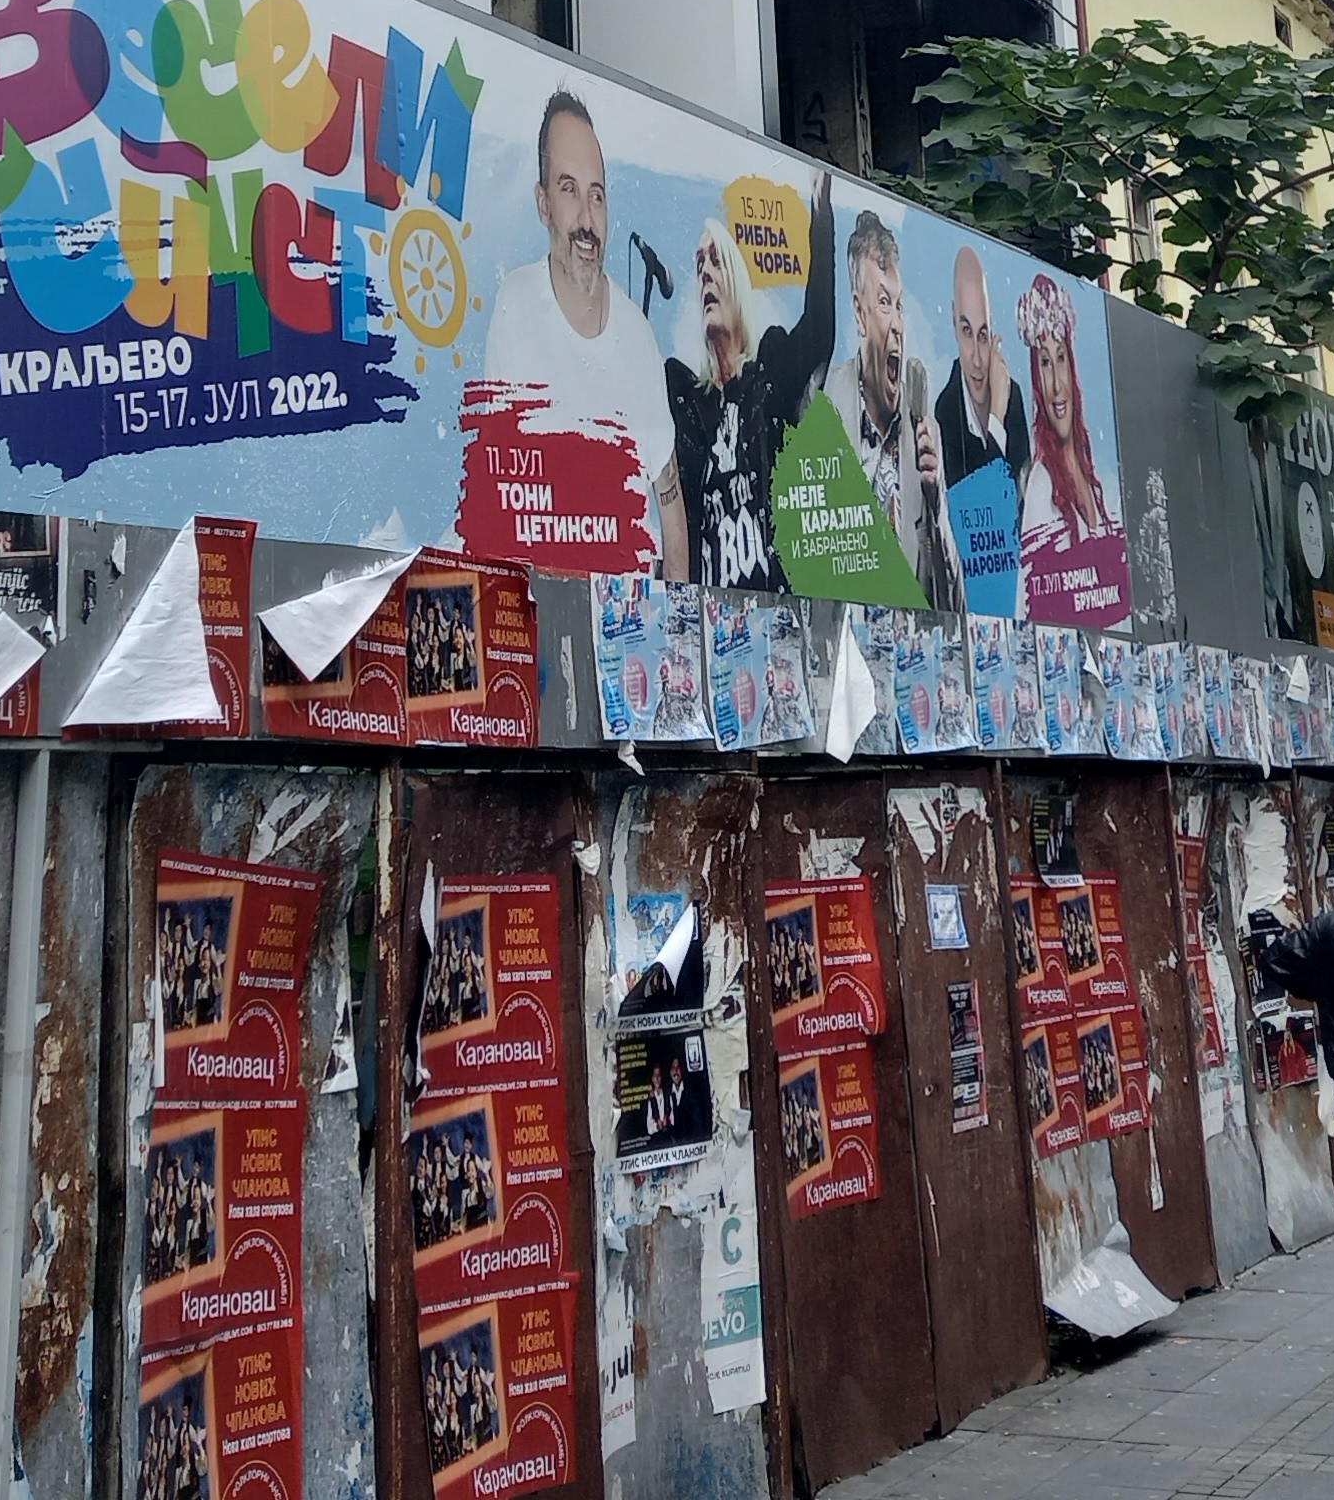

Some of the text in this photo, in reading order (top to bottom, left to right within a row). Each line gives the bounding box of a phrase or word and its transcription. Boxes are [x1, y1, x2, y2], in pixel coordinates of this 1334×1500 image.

[740, 196, 785, 222] 15. ЈУЛ
[734, 222, 789, 249] РИБЉА
[753, 251, 802, 275] ЧОРБА
[114, 371, 349, 434] 15-17. ЈУЛ 2022.
[485, 446, 543, 477] 11. ЈУЛ
[798, 456, 842, 482] 16. ЈУЛ
[497, 482, 553, 512] ТОНИ
[788, 484, 826, 510] НЕЛЕ
[515, 514, 618, 546] ЦЕТИНСКИ
[801, 504, 874, 535] КАРАЈЛИЋ
[959, 507, 994, 530] 16. ЈУЛ
[791, 531, 869, 559] И ЗАБРАЊЕНО
[970, 529, 1006, 553] БОЈАН
[199, 554, 227, 572] ПИС
[832, 551, 880, 576] ПУШЕЊЕ
[201, 577, 231, 596] ОВИХ
[1044, 572, 1061, 595] ЈУЛ
[1062, 566, 1100, 592] ЗОРИЦА
[202, 602, 240, 618] АНОВА
[1073, 585, 1121, 613] БРУНЦЛИК
[308, 700, 400, 741] Карановац
[451, 708, 527, 742] Карановац
[508, 908, 535, 924] УПИС
[505, 928, 540, 945] НОВИХ
[499, 949, 548, 966] ЧЛАНОВА
[637, 1013, 663, 1028] НОВИХ
[663, 1011, 699, 1026] ЧЛАНОВА
[798, 1011, 862, 1038] Карановац
[187, 1046, 275, 1086] Карановац
[456, 1040, 543, 1070] Карановац
[515, 1104, 543, 1122] УПИС
[246, 1128, 277, 1148] УПИС
[514, 1125, 549, 1145] НОВИХ
[241, 1153, 282, 1173] НОВИХ
[508, 1145, 558, 1167] ЧЛАНОВА
[641, 1149, 671, 1167] НОВИХ
[671, 1144, 709, 1163] ЧЛАНОВА
[233, 1177, 290, 1198] ЧЛАНОВА
[806, 1176, 867, 1208] Карановац
[461, 1242, 551, 1280] Карановац
[182, 1289, 276, 1327] Карановац
[521, 1309, 550, 1330] УПИС
[518, 1330, 555, 1354] НОВИХ
[238, 1352, 272, 1377] УПИС
[511, 1352, 563, 1377] ЧЛАНОВА
[235, 1377, 277, 1405] НОВИХ
[226, 1401, 286, 1432] ЧЛАНОВА
[473, 1454, 556, 1498] Карановац
